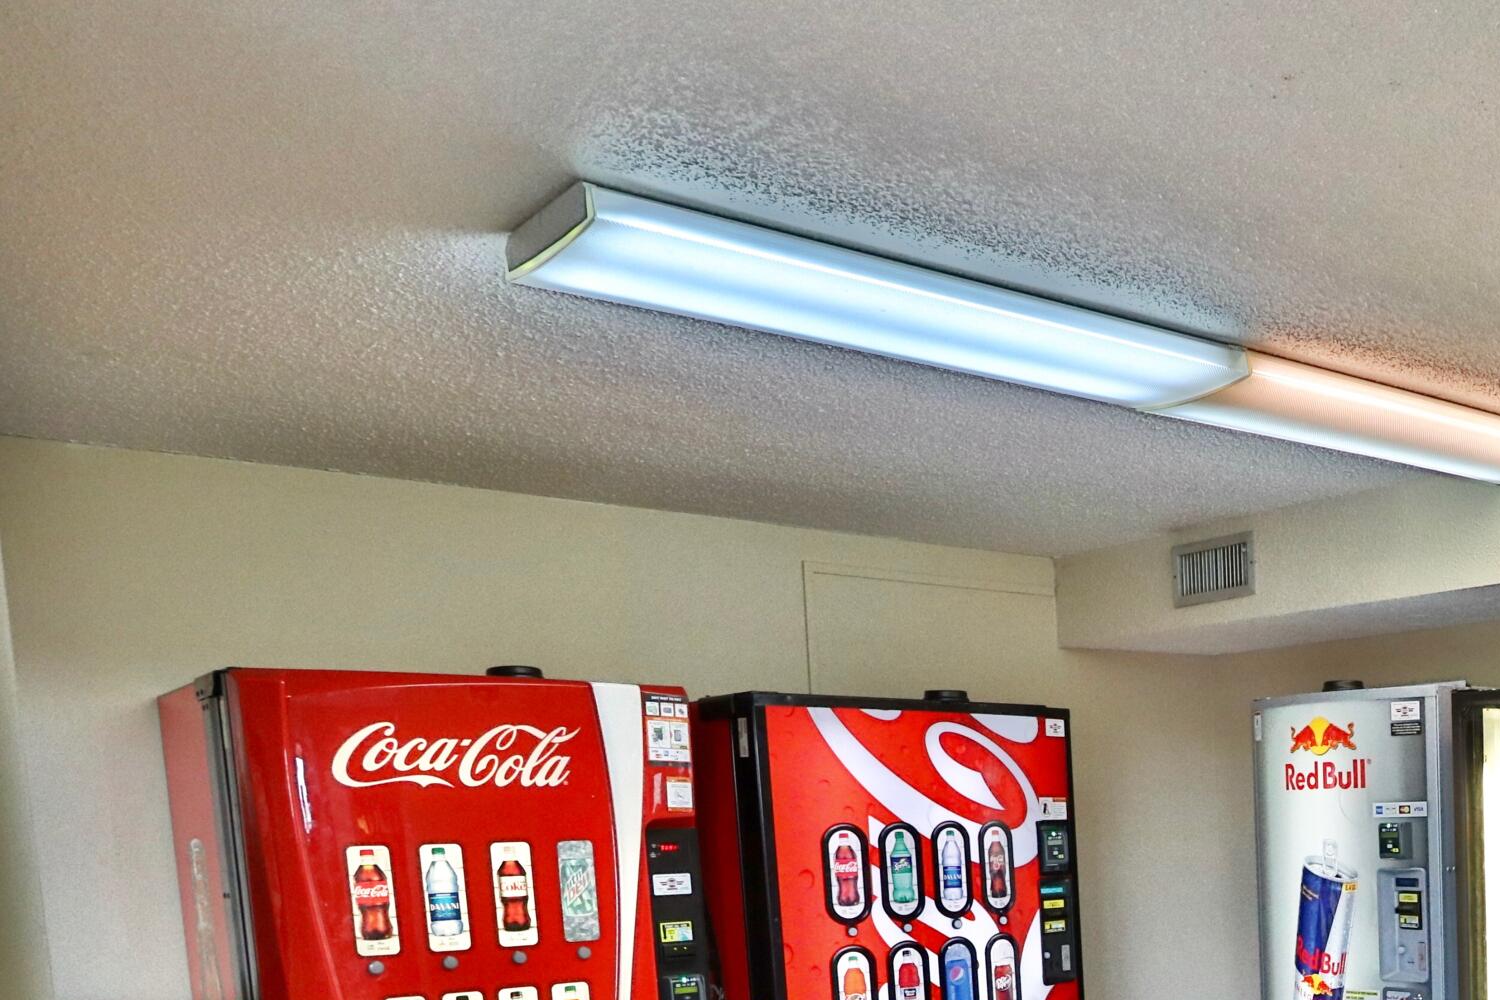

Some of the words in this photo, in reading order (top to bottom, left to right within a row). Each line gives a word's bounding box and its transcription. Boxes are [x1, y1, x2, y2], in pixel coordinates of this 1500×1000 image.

[331, 720, 581, 788] Coca-Cola
[1285, 761, 1318, 790] Red
[1323, 758, 1366, 789] Bull
[1296, 936, 1319, 970] Red
[1320, 952, 1347, 976] Bull
